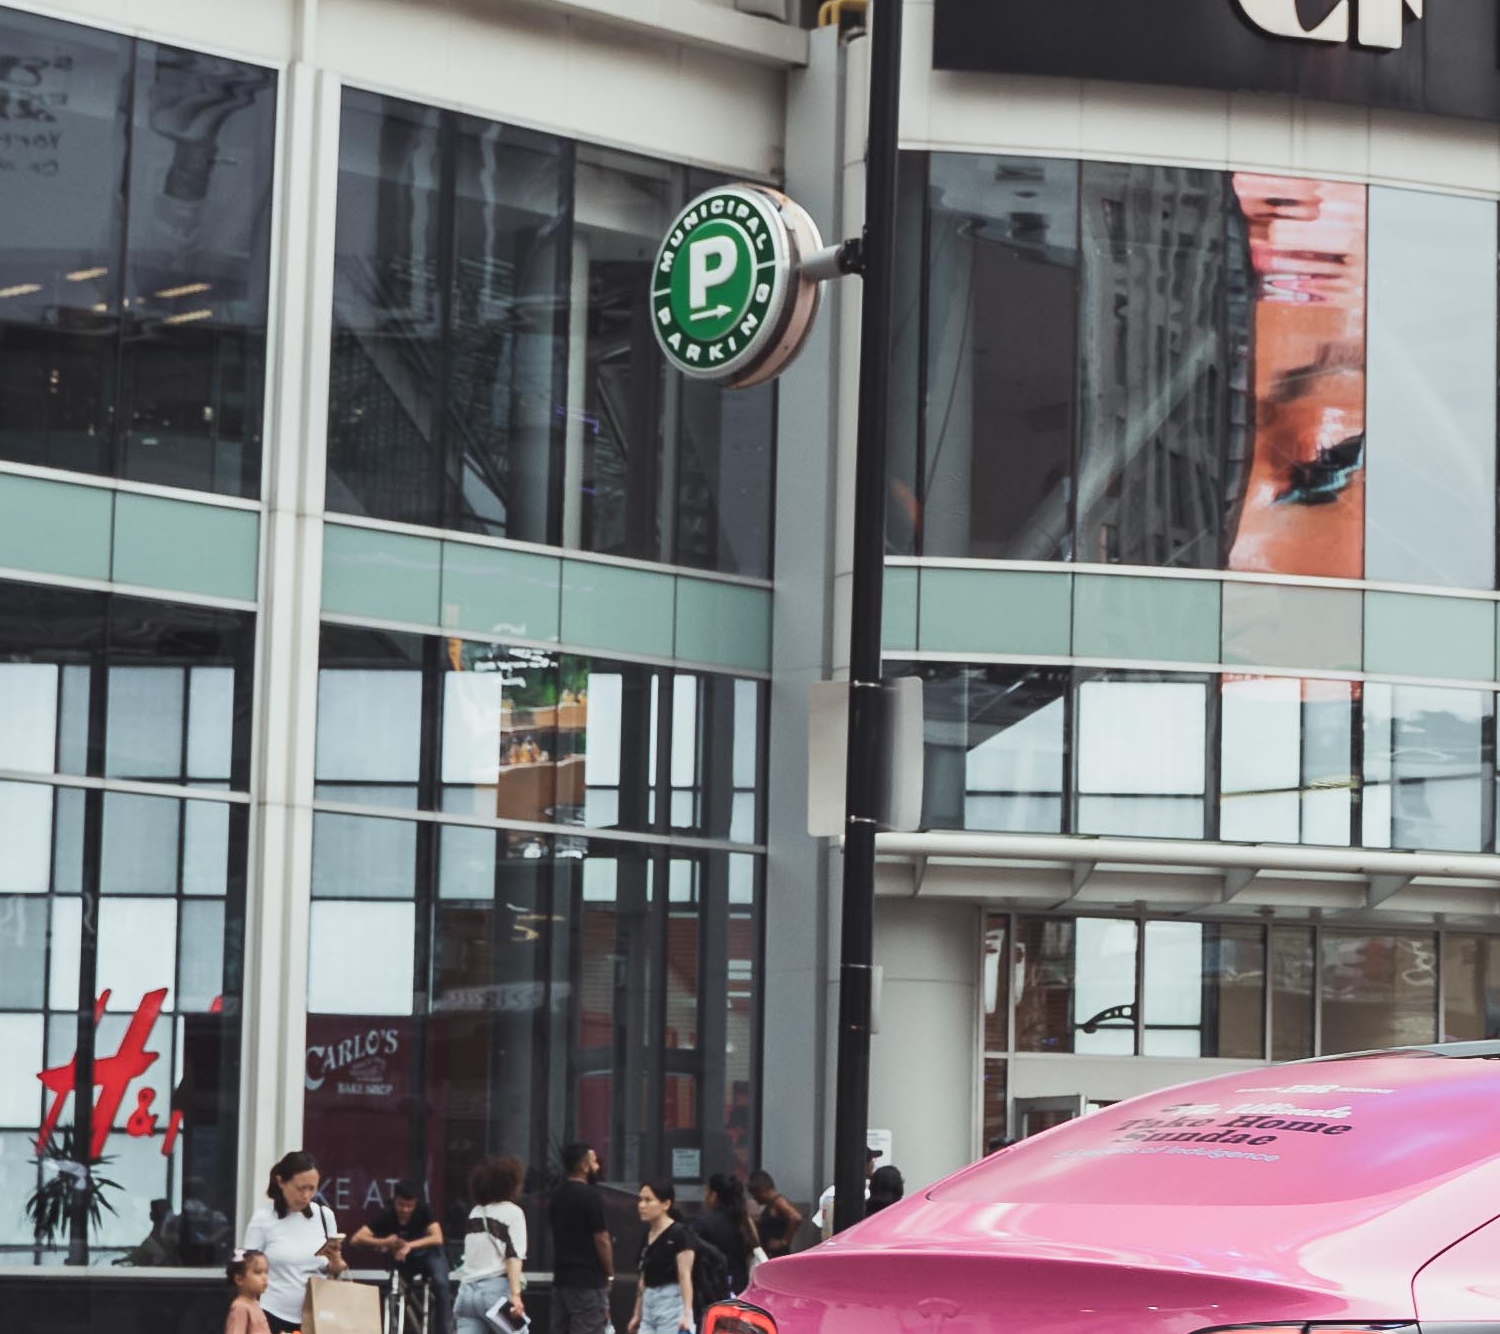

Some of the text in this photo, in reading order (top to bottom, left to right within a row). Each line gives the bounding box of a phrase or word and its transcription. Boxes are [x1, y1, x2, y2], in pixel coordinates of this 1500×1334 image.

[660, 198, 768, 273] MUNICIPAL
[689, 235, 738, 310] P
[658, 282, 770, 361] PARKING
[1112, 1115, 1354, 1136] Take Home
[1112, 1129, 1279, 1146] Sundae
